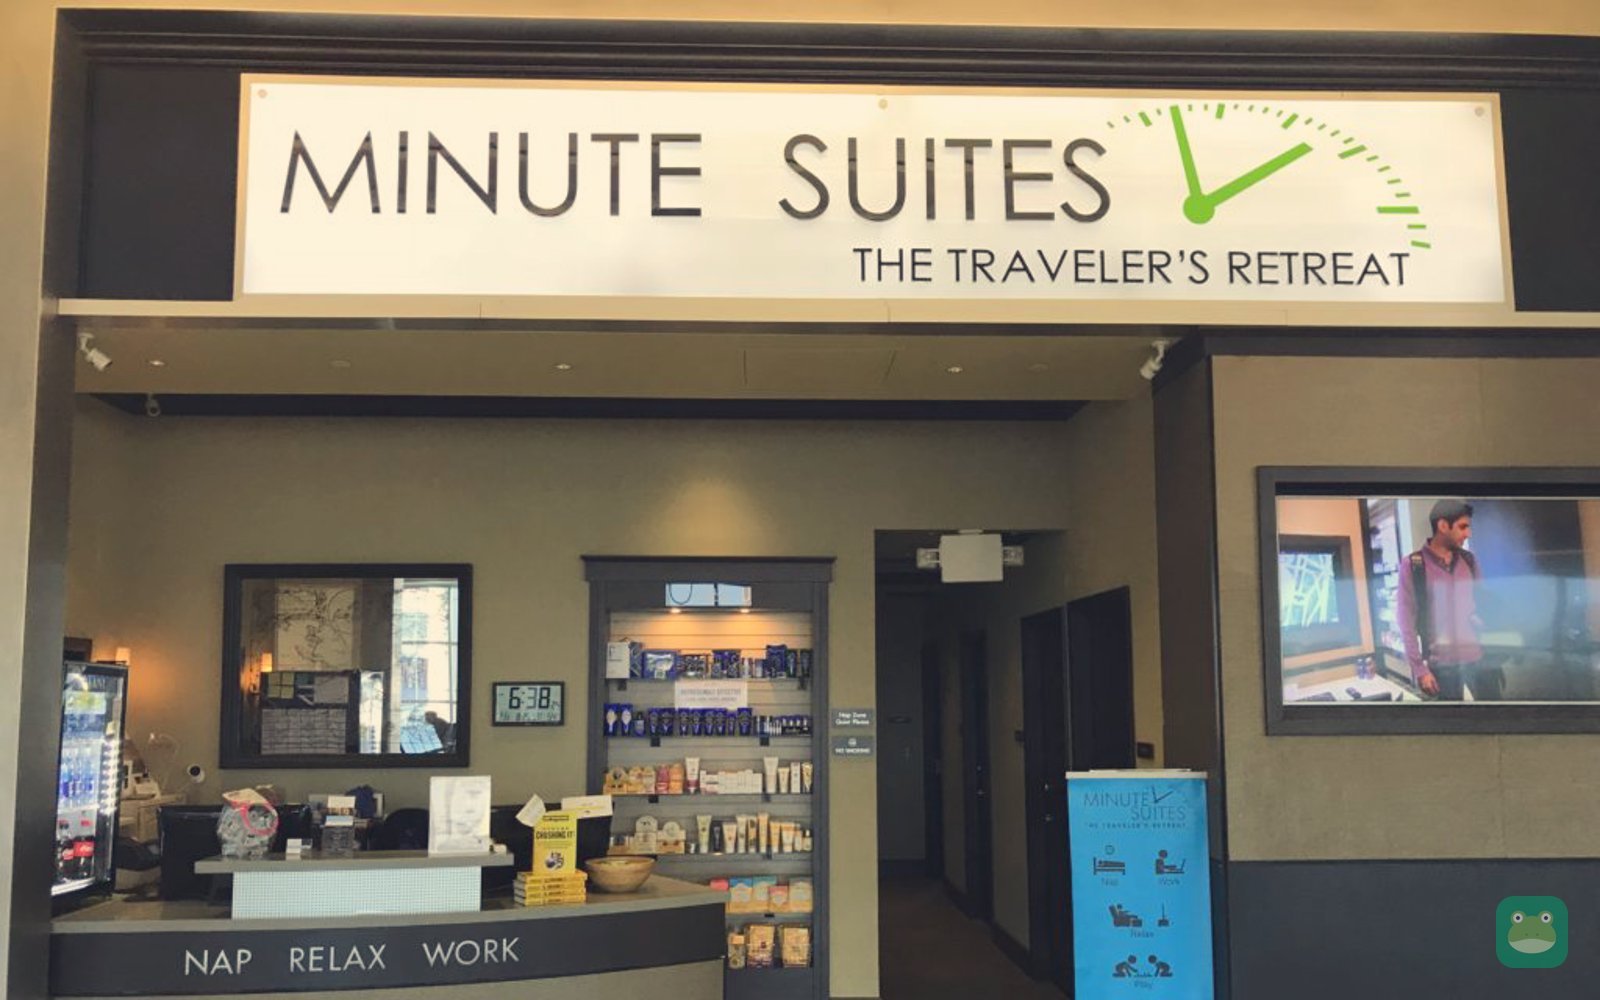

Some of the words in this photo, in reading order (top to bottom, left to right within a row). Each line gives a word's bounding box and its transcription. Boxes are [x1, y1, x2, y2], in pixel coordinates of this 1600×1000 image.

[280, 130, 703, 218] MINUTE
[778, 133, 1112, 223] SUITES
[853, 248, 933, 284] THE
[947, 249, 1211, 286] TRAVELER'S
[1227, 251, 1411, 288] RETREAT
[508, 686, 551, 709] 6:38
[1083, 791, 1150, 808] MINUTE
[1131, 805, 1187, 821] SUITES
[184, 949, 252, 976] NAP
[289, 943, 387, 973] RELAX
[422, 937, 520, 967] WORK
